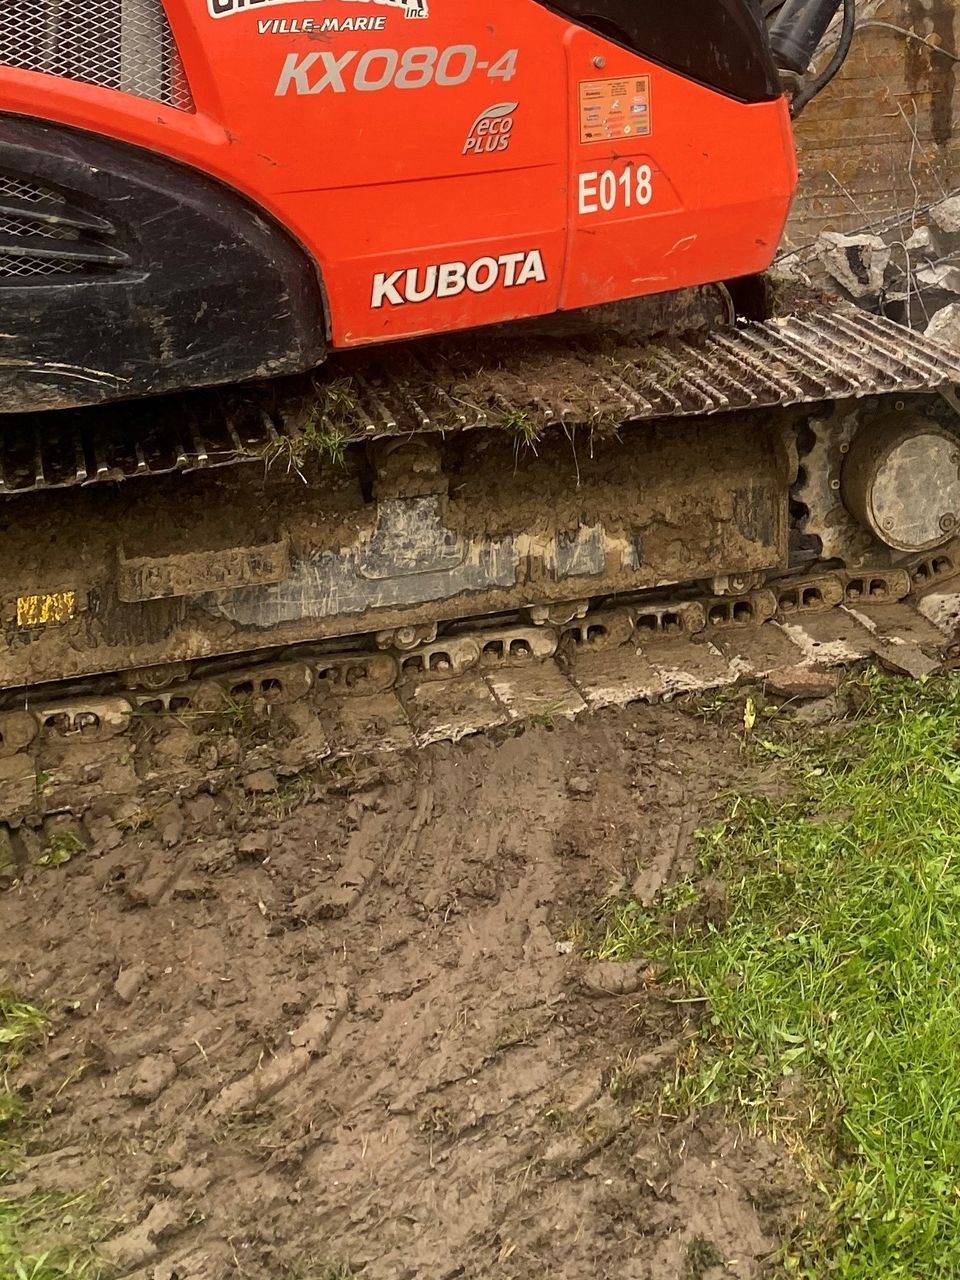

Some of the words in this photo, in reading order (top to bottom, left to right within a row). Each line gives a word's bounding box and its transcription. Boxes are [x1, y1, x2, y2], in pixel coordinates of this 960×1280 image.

[257, 16, 386, 34] VILLE-MARIE
[274, 44, 519, 96] KX080-4
[461, 133, 510, 155] PLUS
[476, 117, 513, 136] eco
[578, 164, 652, 215] E018
[370, 249, 546, 308] KUBOTA
